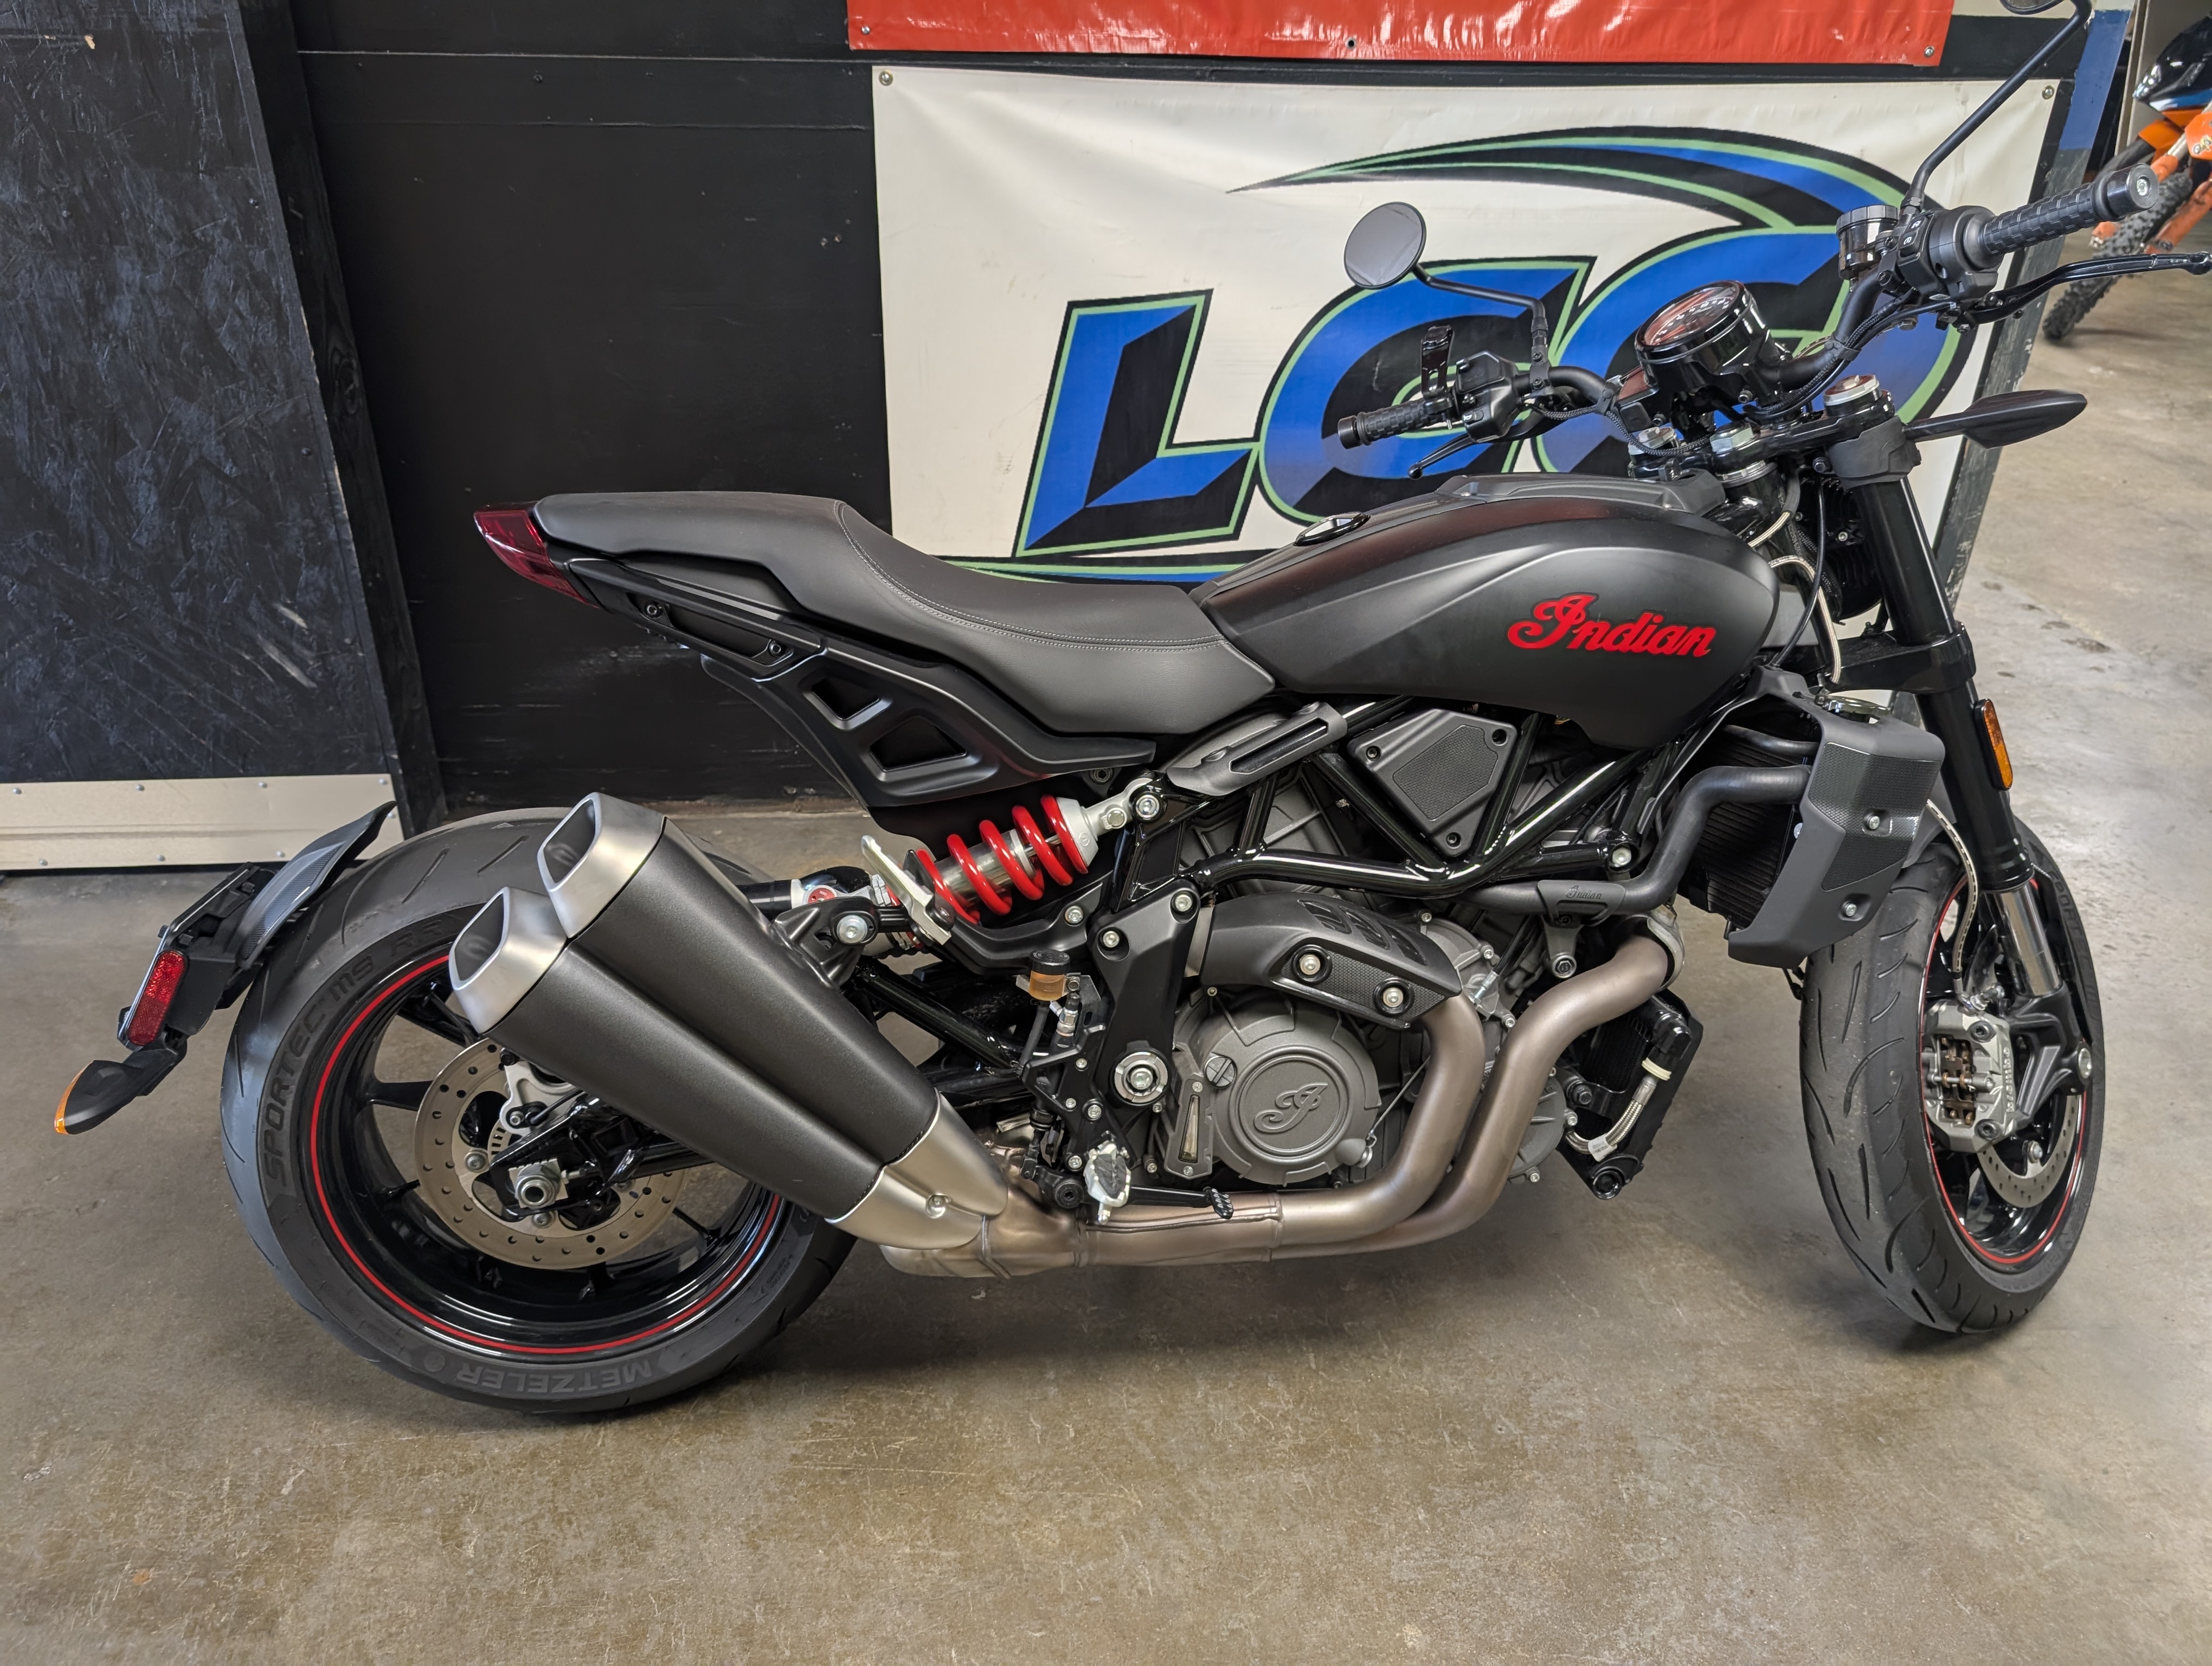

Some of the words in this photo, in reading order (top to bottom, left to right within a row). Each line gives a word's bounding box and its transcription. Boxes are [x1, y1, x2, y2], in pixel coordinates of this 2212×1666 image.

[1508, 593, 1716, 657] Indian
[1565, 885, 1602, 900] Indian
[263, 997, 327, 1187] SPORTEC
[2002, 1046, 2015, 1113] brembo
[456, 1361, 650, 1394] METZELER
